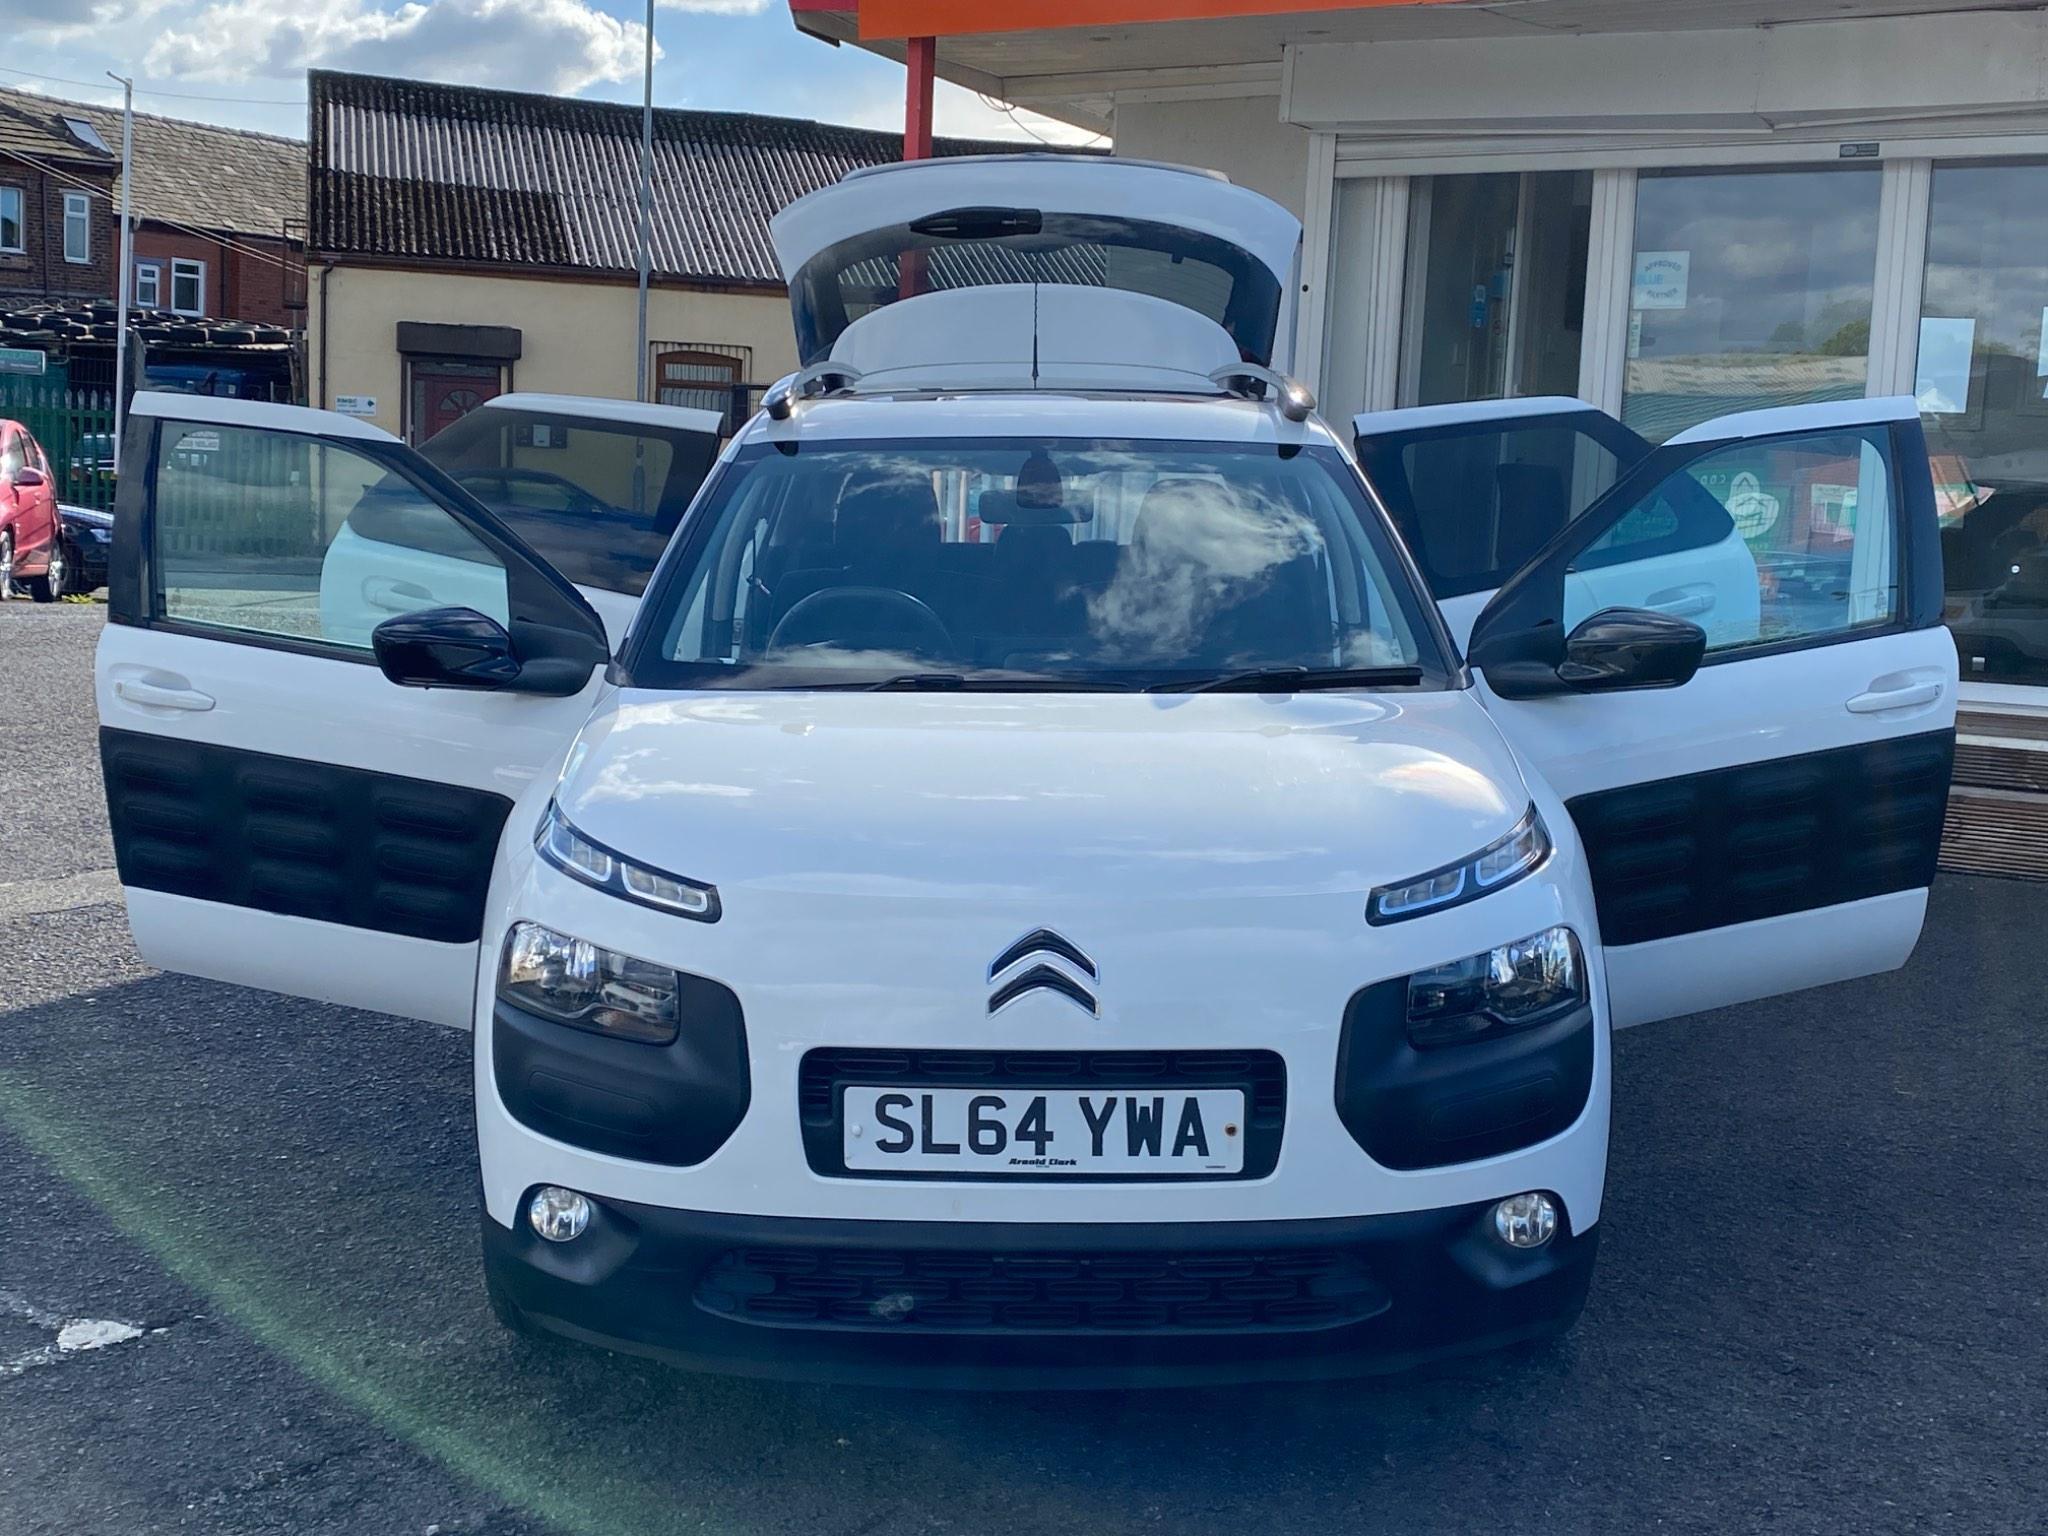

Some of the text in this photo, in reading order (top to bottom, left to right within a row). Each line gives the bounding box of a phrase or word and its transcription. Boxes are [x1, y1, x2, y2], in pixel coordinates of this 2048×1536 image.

[1644, 260, 1682, 272] APPROVED
[874, 1093, 1210, 1157] SL64 YWA
[1009, 1158, 1078, 1166] Arnold Clark
